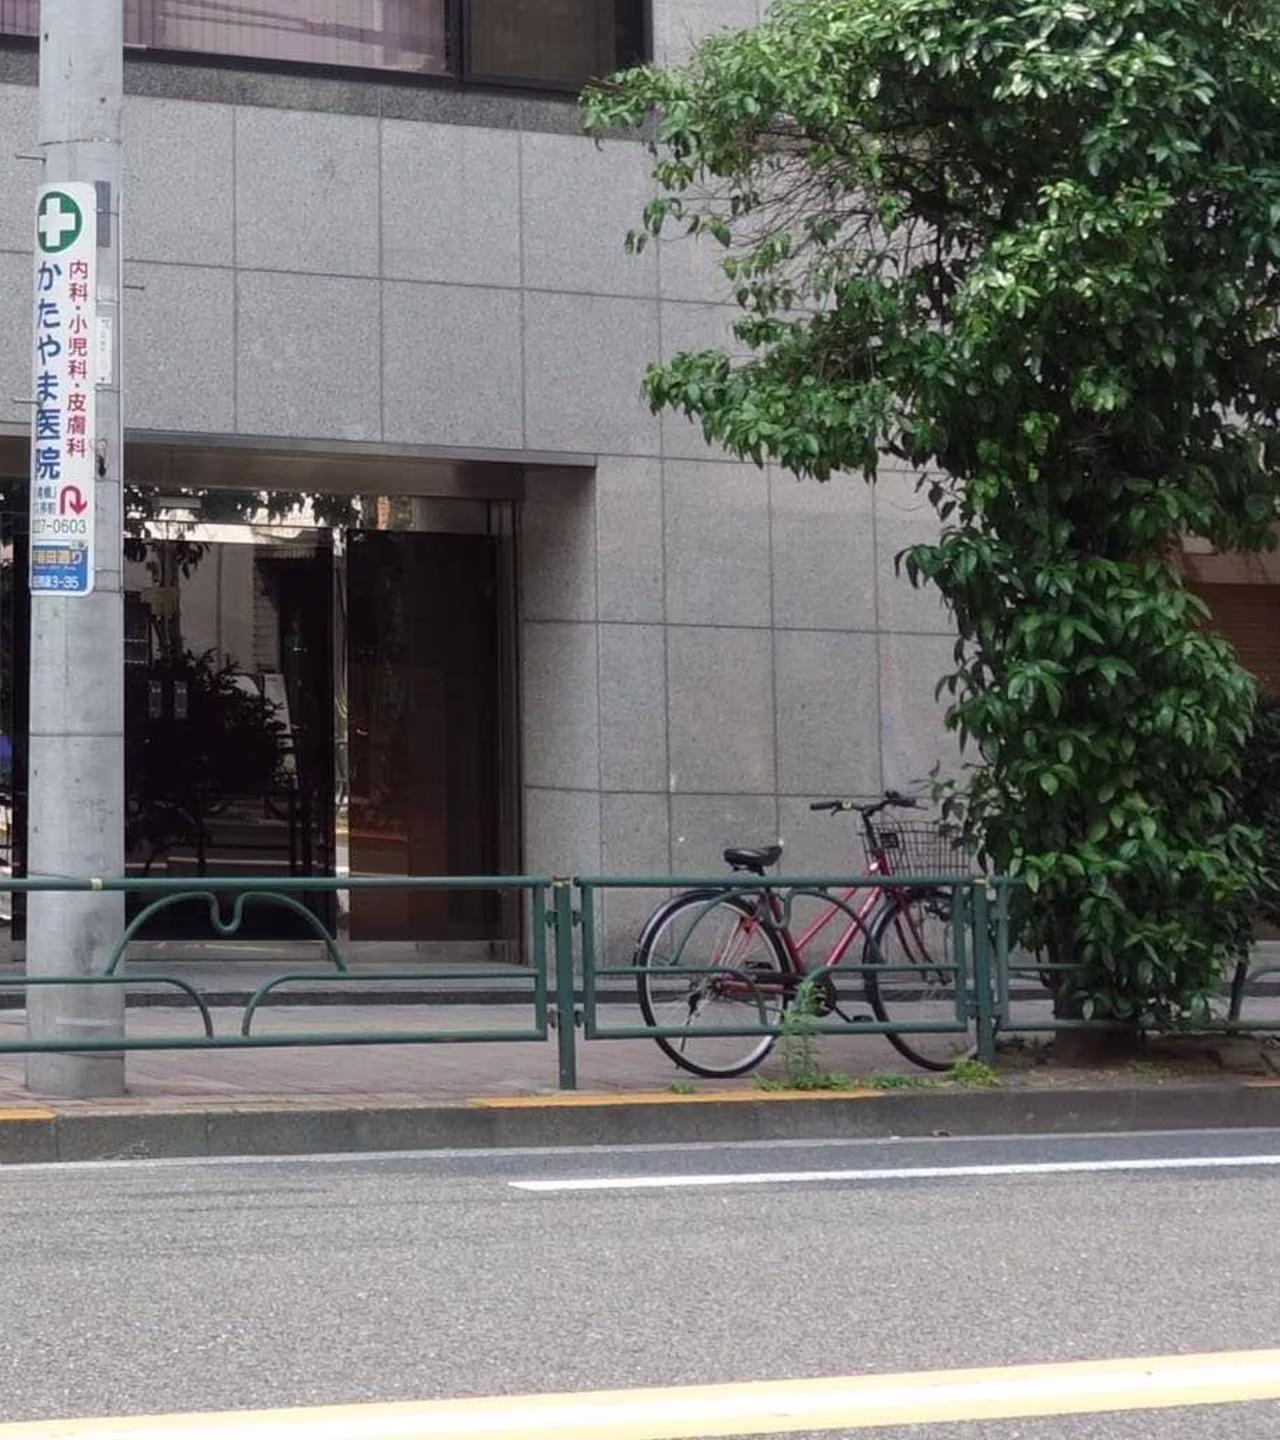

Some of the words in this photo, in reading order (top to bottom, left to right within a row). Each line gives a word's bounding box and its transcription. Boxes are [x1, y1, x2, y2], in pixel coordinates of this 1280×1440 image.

[36, 261, 61, 480] かたやま医院
